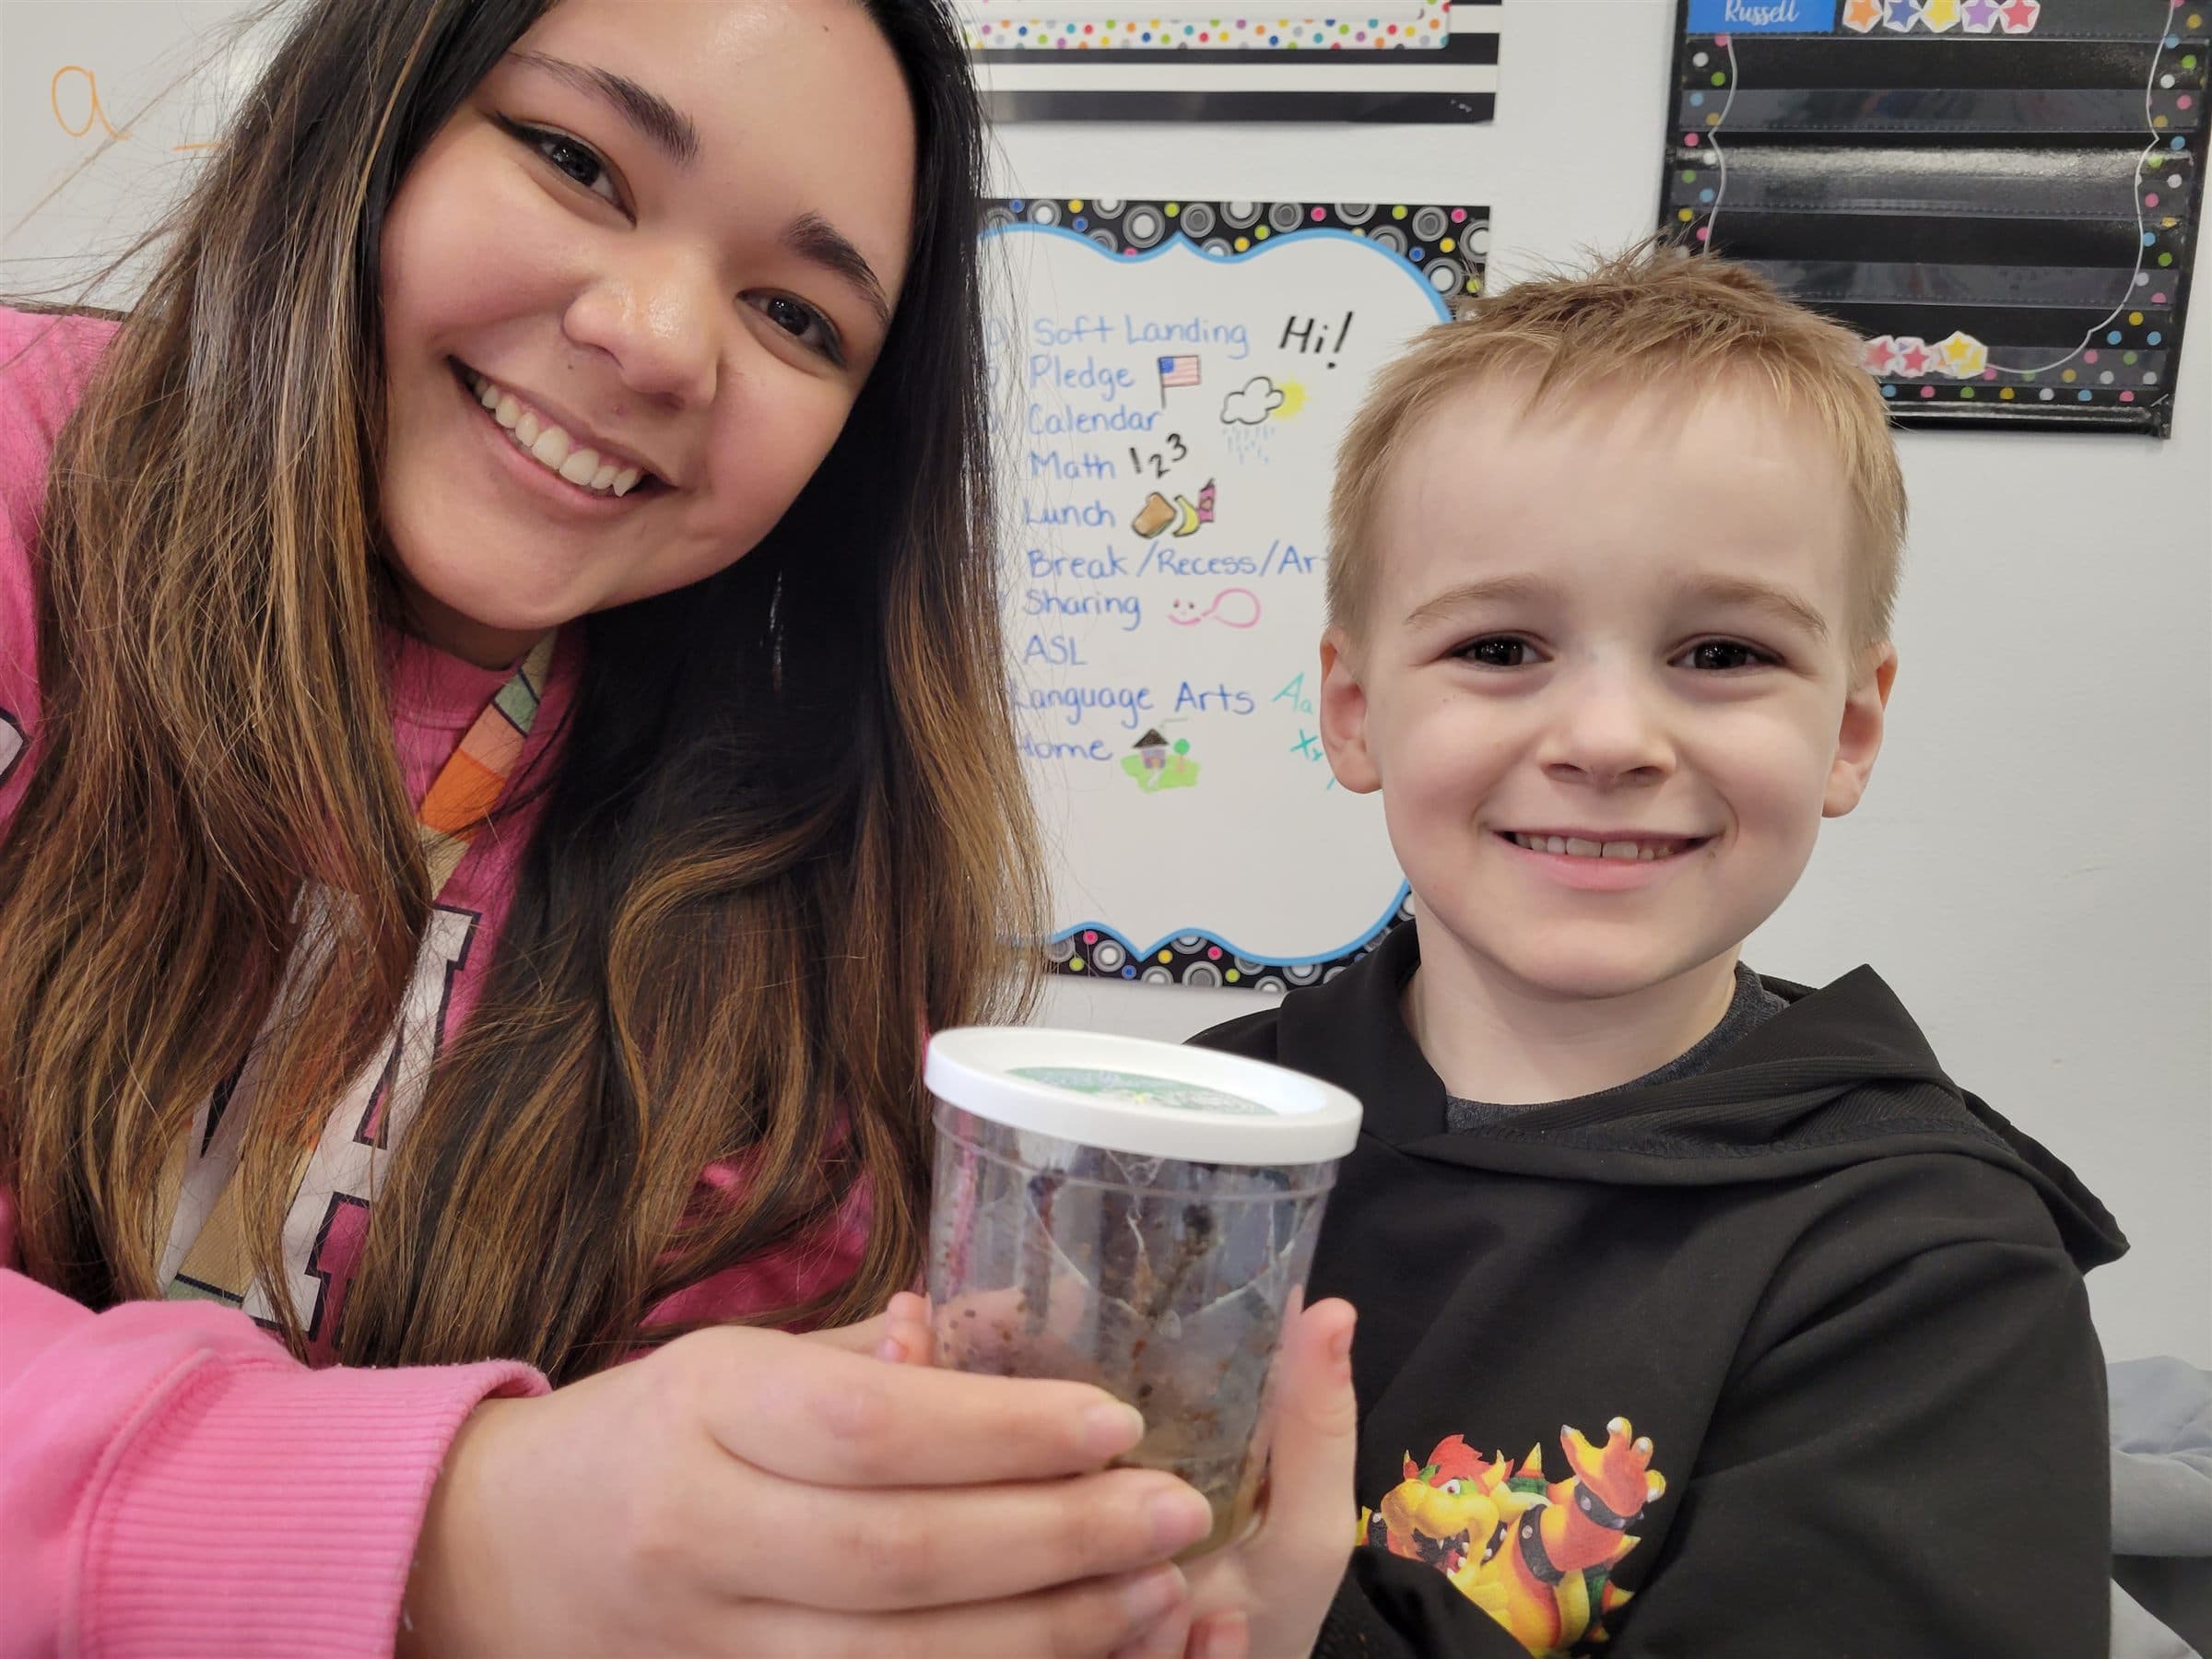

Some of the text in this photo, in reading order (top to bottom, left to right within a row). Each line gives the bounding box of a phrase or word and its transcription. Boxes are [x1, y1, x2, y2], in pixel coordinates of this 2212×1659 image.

[1724, 0, 1800, 26] Russell
[51, 65, 132, 140] a
[1032, 313, 1115, 347] Soft
[1124, 313, 1250, 360] Landing
[1277, 311, 1354, 370] Hi!
[1029, 354, 1136, 403] Pledge
[1028, 403, 1162, 436] Calendar
[1030, 450, 1116, 480] Math
[1021, 496, 1116, 528] Lunch
[1022, 588, 1141, 631] Sharing
[1022, 633, 1088, 666] ASL
[1174, 680, 1255, 715] Arts
